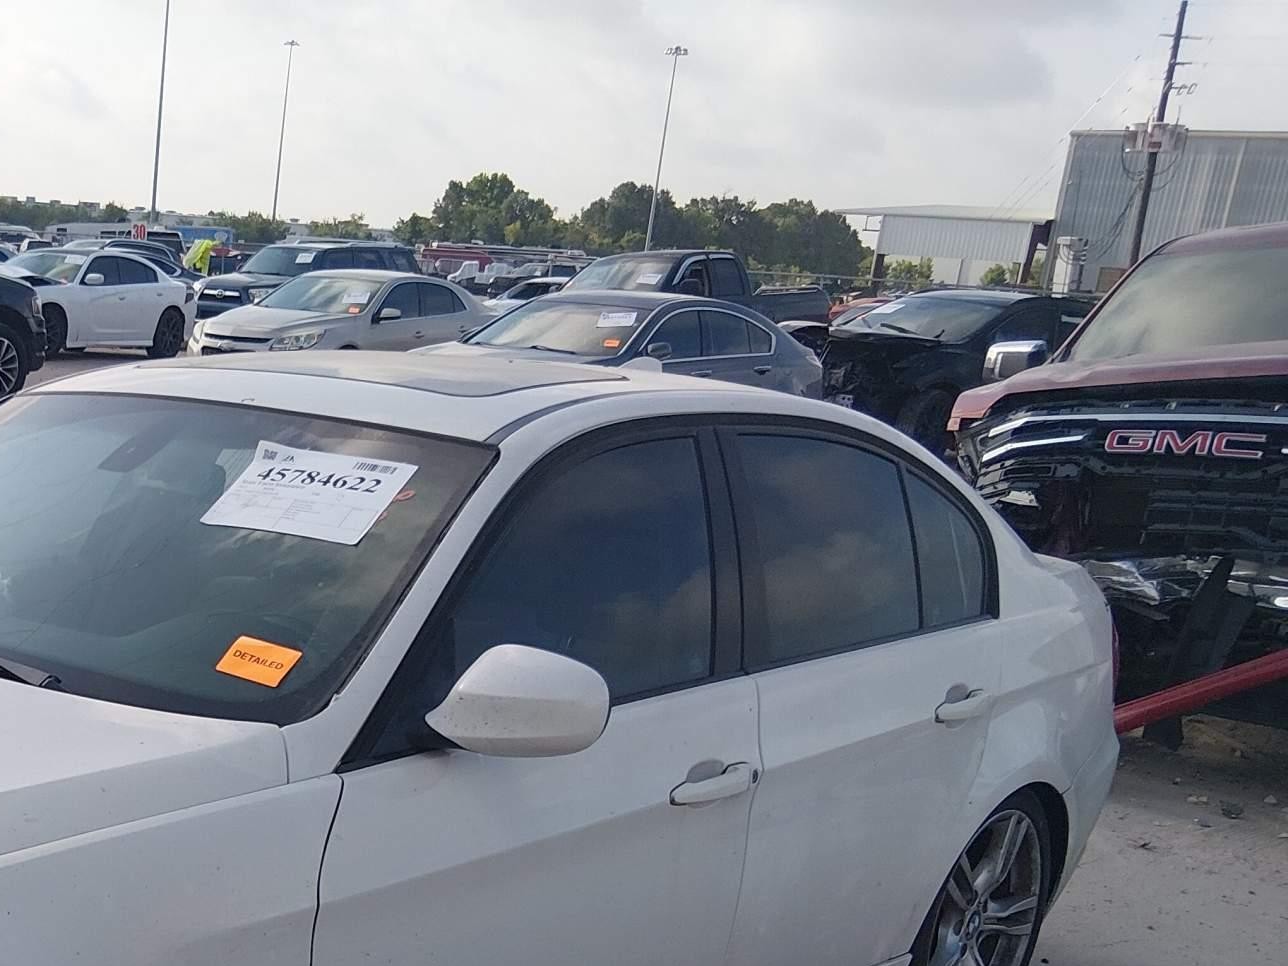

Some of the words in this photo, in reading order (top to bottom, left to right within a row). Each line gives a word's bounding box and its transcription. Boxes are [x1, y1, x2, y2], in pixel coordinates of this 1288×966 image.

[133, 224, 145, 240] 30
[1104, 430, 1267, 459] GMC
[257, 466, 382, 494] 45784622
[233, 649, 284, 670] DETAILED
